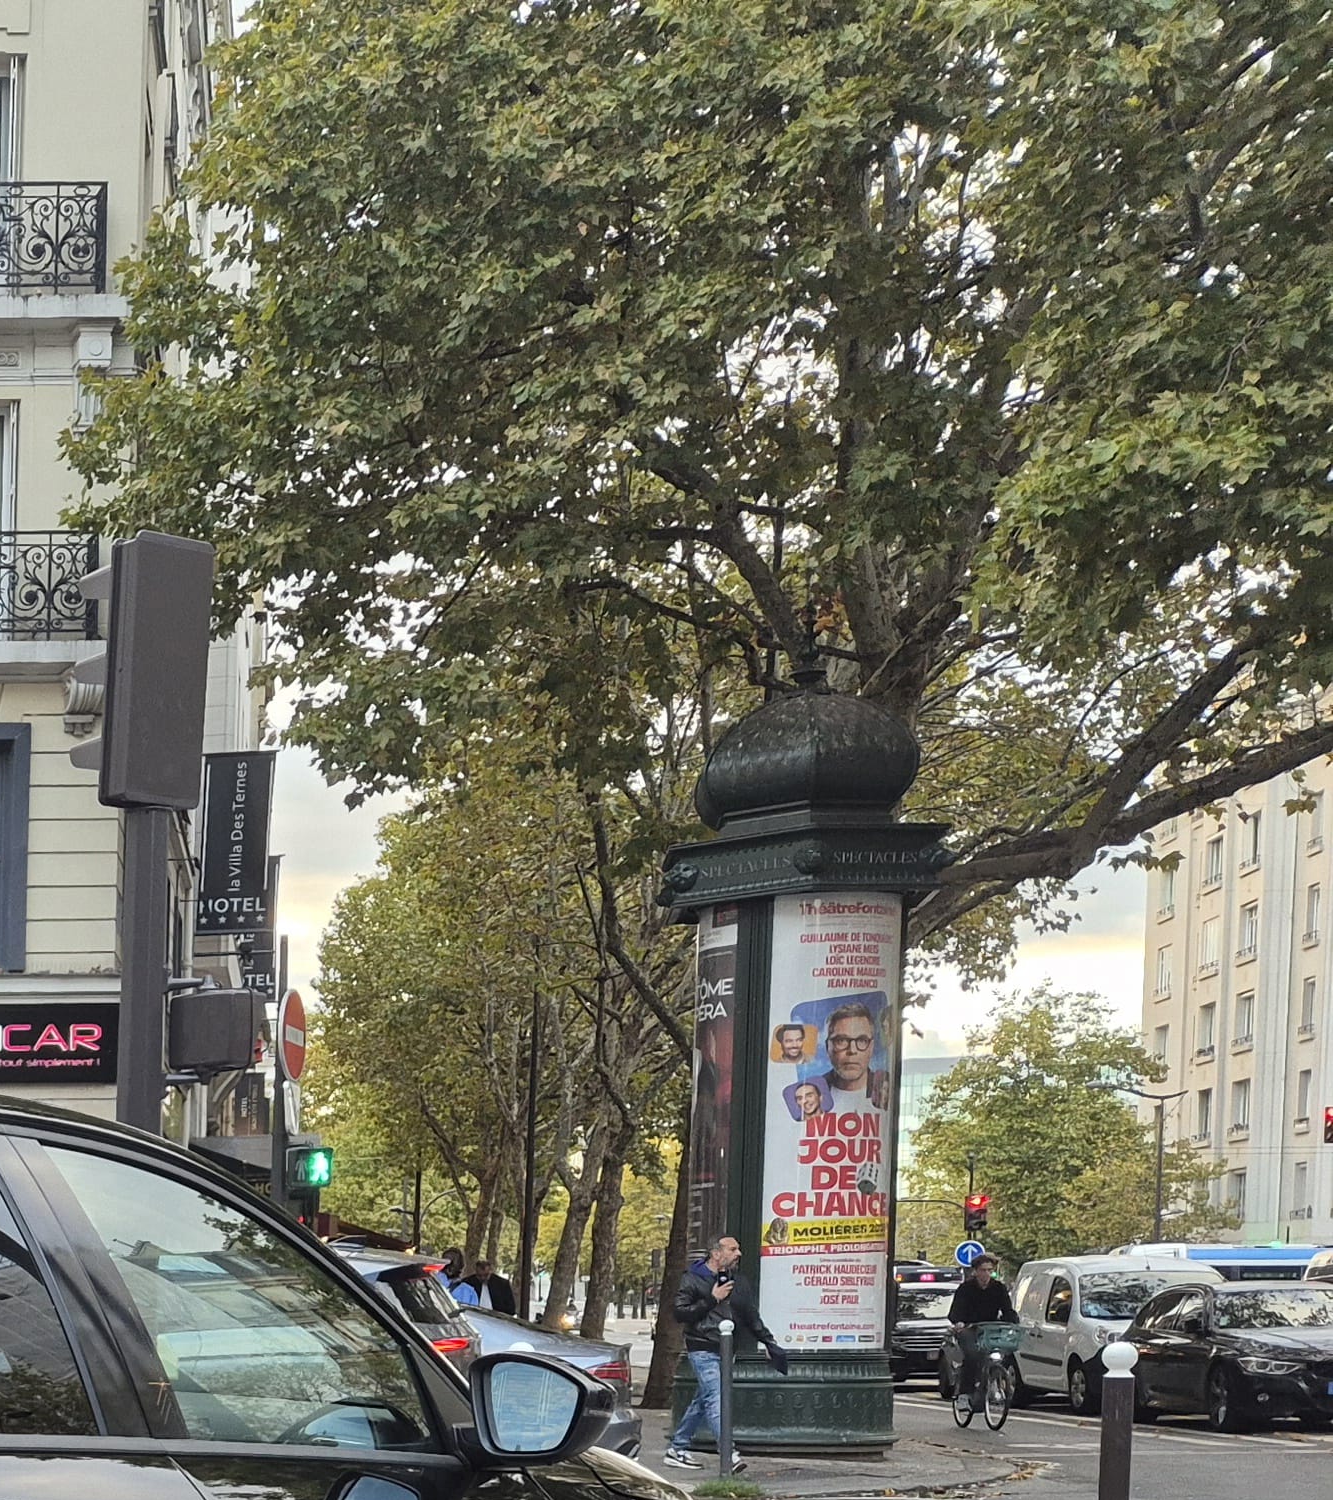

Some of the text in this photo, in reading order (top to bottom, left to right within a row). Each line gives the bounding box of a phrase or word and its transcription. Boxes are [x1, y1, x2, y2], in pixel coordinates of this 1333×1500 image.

[227, 761, 248, 892] la Villa Des Ternes
[700, 855, 791, 880] SPECTACLES
[833, 850, 918, 865] SPECTACLES
[806, 1112, 880, 1137] MON
[798, 1138, 882, 1164] JOUR
[811, 1165, 857, 1190] DE
[772, 1191, 887, 1218] CHANCE
[792, 1264, 831, 1274] PATRICK
